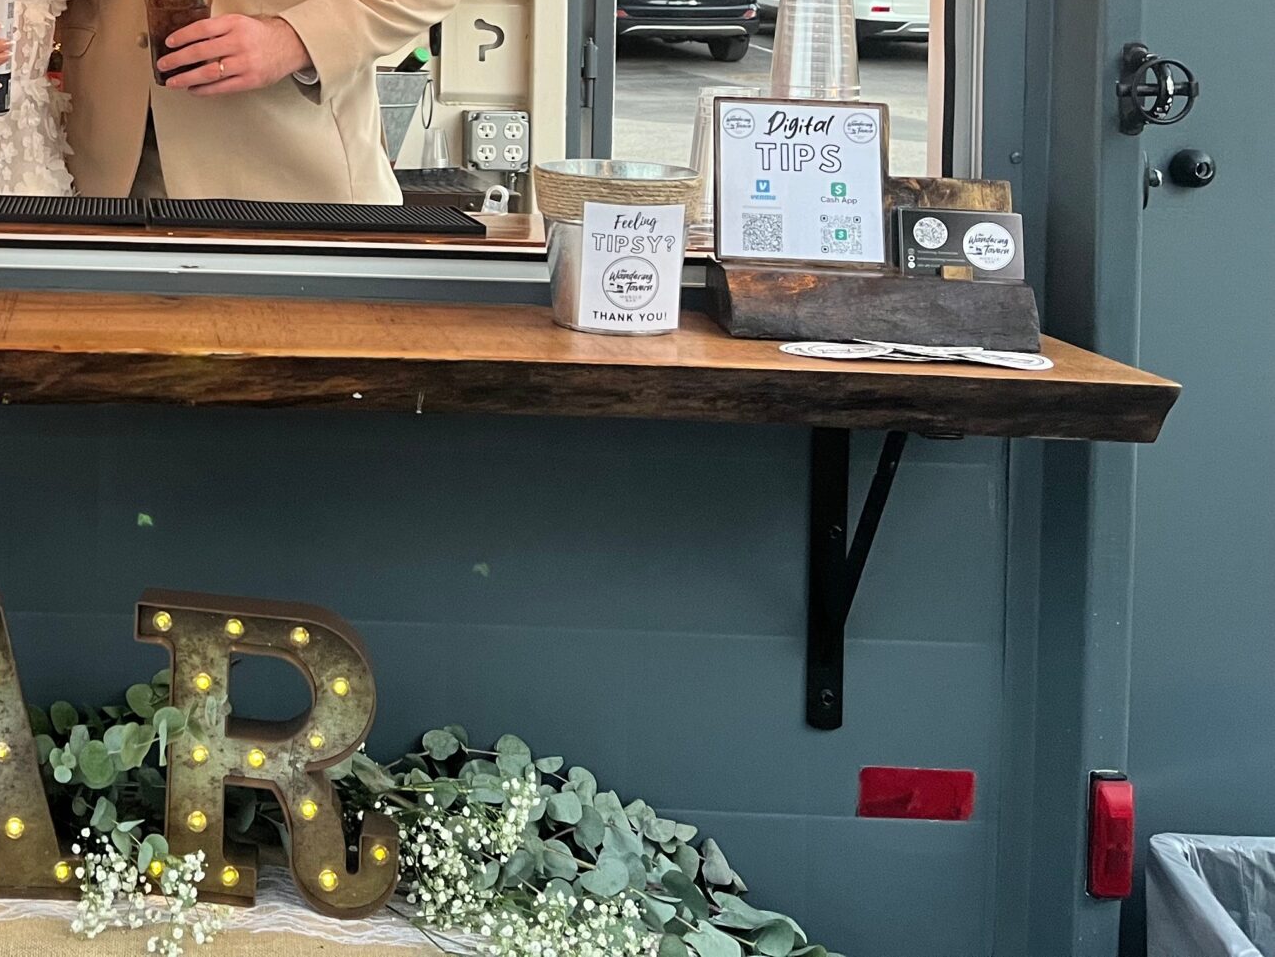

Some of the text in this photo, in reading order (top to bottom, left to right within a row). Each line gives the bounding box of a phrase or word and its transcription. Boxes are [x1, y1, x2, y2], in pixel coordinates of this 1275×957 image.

[763, 110, 836, 140] Digital
[755, 142, 842, 174] TIPS
[820, 196, 858, 205] Cash App
[613, 211, 659, 234] Feeling
[591, 232, 676, 255] TIPSY?
[968, 235, 1009, 248] Wandering
[983, 245, 1010, 256] Tavern
[609, 270, 653, 284] Wandering
[625, 282, 654, 294] Tavern
[592, 310, 668, 323] THANK YOU!
